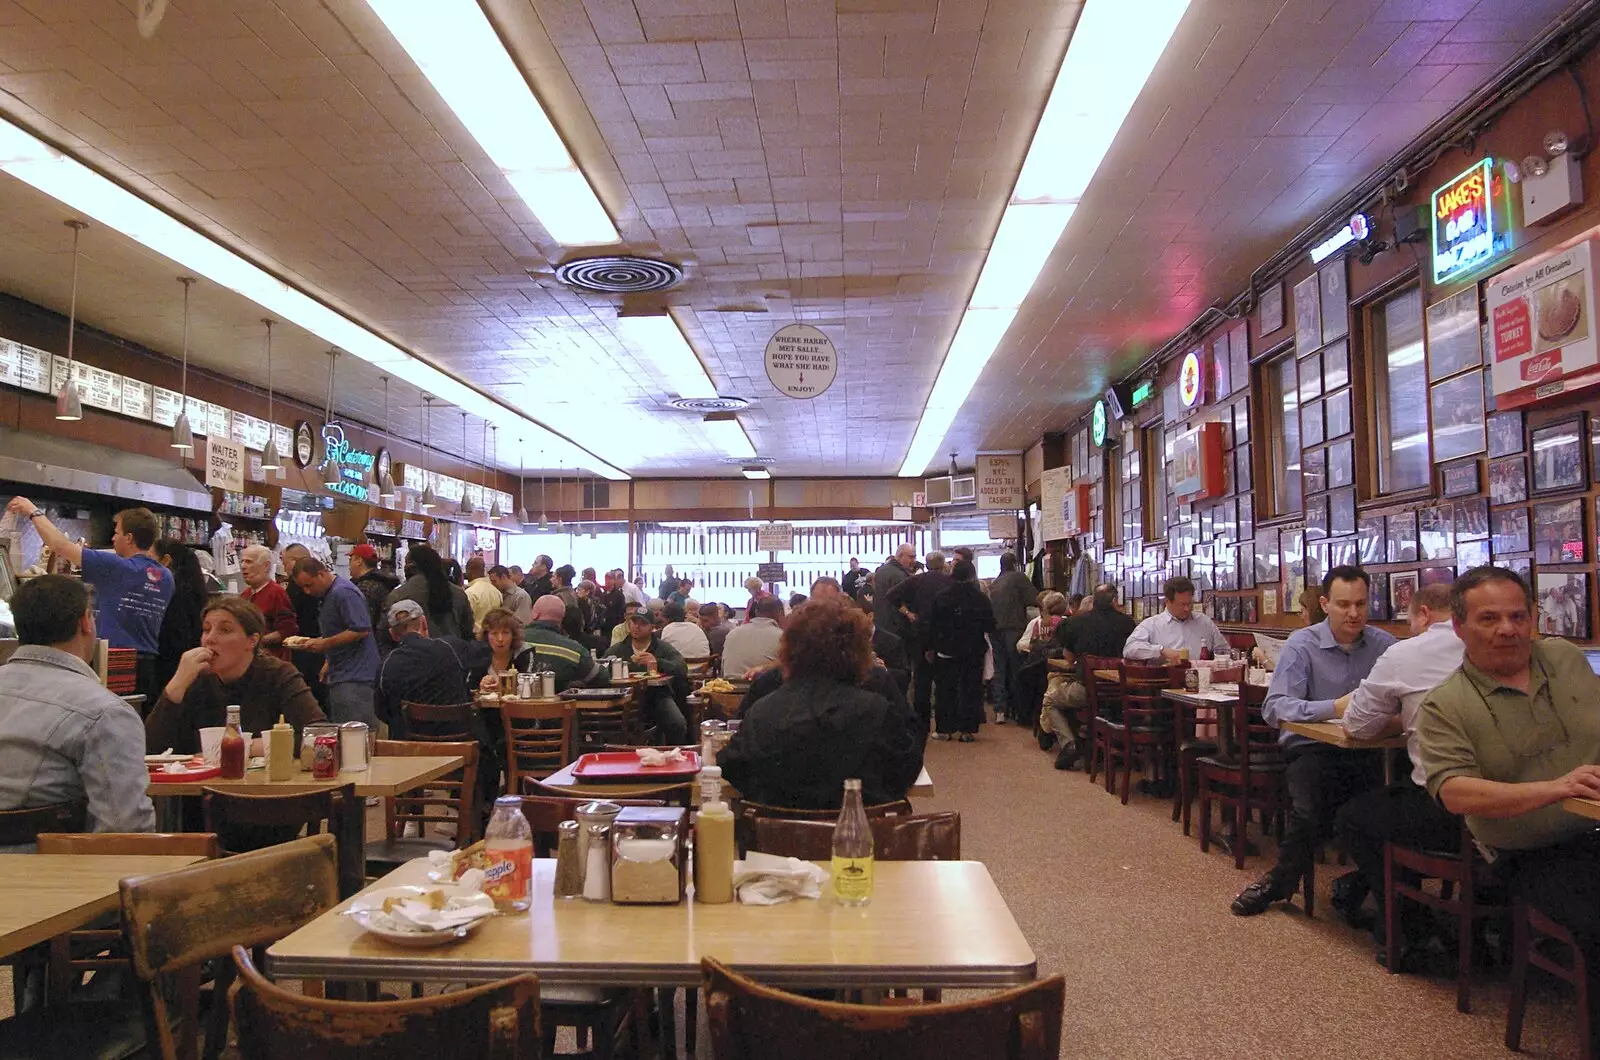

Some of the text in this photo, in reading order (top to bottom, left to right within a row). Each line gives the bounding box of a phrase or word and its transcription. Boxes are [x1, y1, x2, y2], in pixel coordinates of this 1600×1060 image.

[774, 336, 828, 345] WHERE HARRY
[1500, 325, 1524, 344] TURKEY
[794, 354, 810, 362] YOU
[811, 355, 831, 363] HAVE
[772, 362, 794, 370] WHAT
[211, 442, 238, 460] WAITER
[339, 440, 376, 472] Catering
[210, 455, 238, 472] SERVICE
[212, 468, 228, 481] ONLY
[980, 487, 1021, 495] ADDED BY THE
